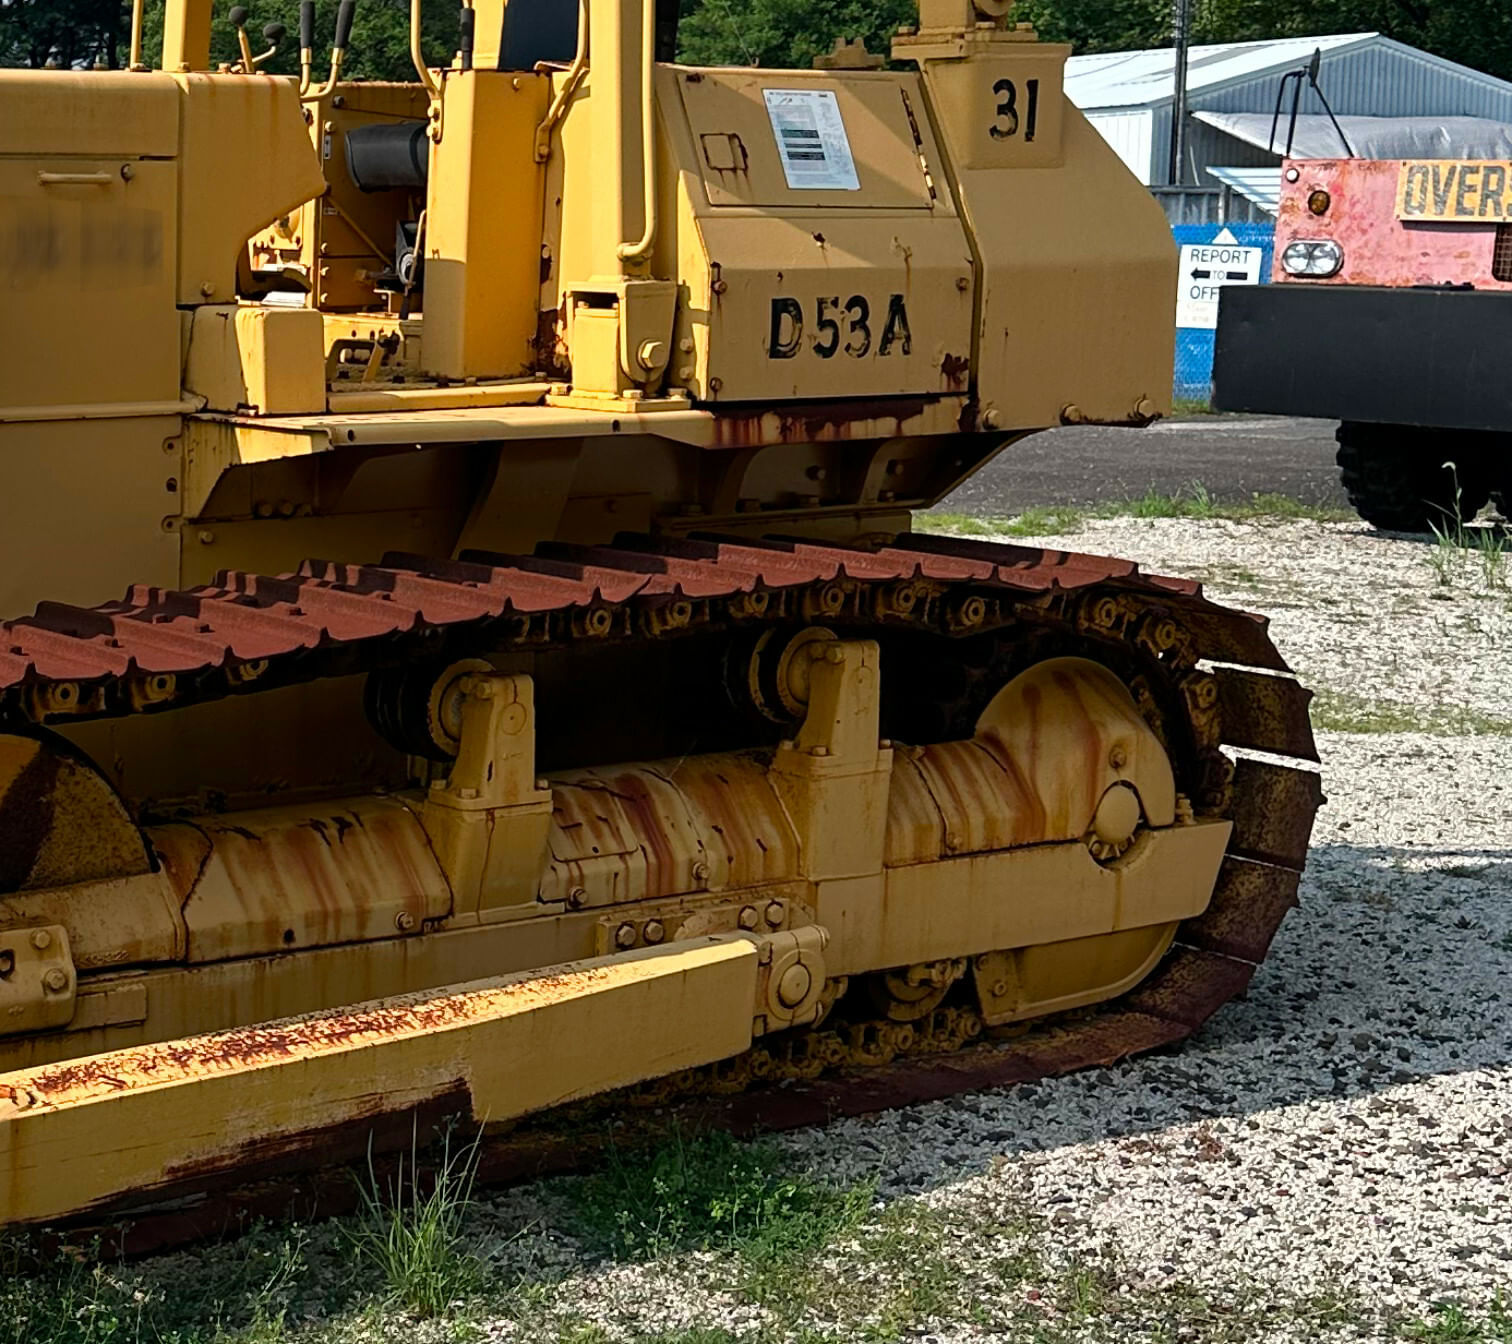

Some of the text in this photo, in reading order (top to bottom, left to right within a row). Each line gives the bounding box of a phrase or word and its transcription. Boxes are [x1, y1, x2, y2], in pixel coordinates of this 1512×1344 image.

[989, 78, 1039, 142] 31
[1404, 164, 1512, 216] OVER
[1190, 248, 1251, 264] REPORT
[1189, 285, 1219, 300] OFF
[1213, 270, 1226, 281] TO
[768, 293, 912, 359] D53A
